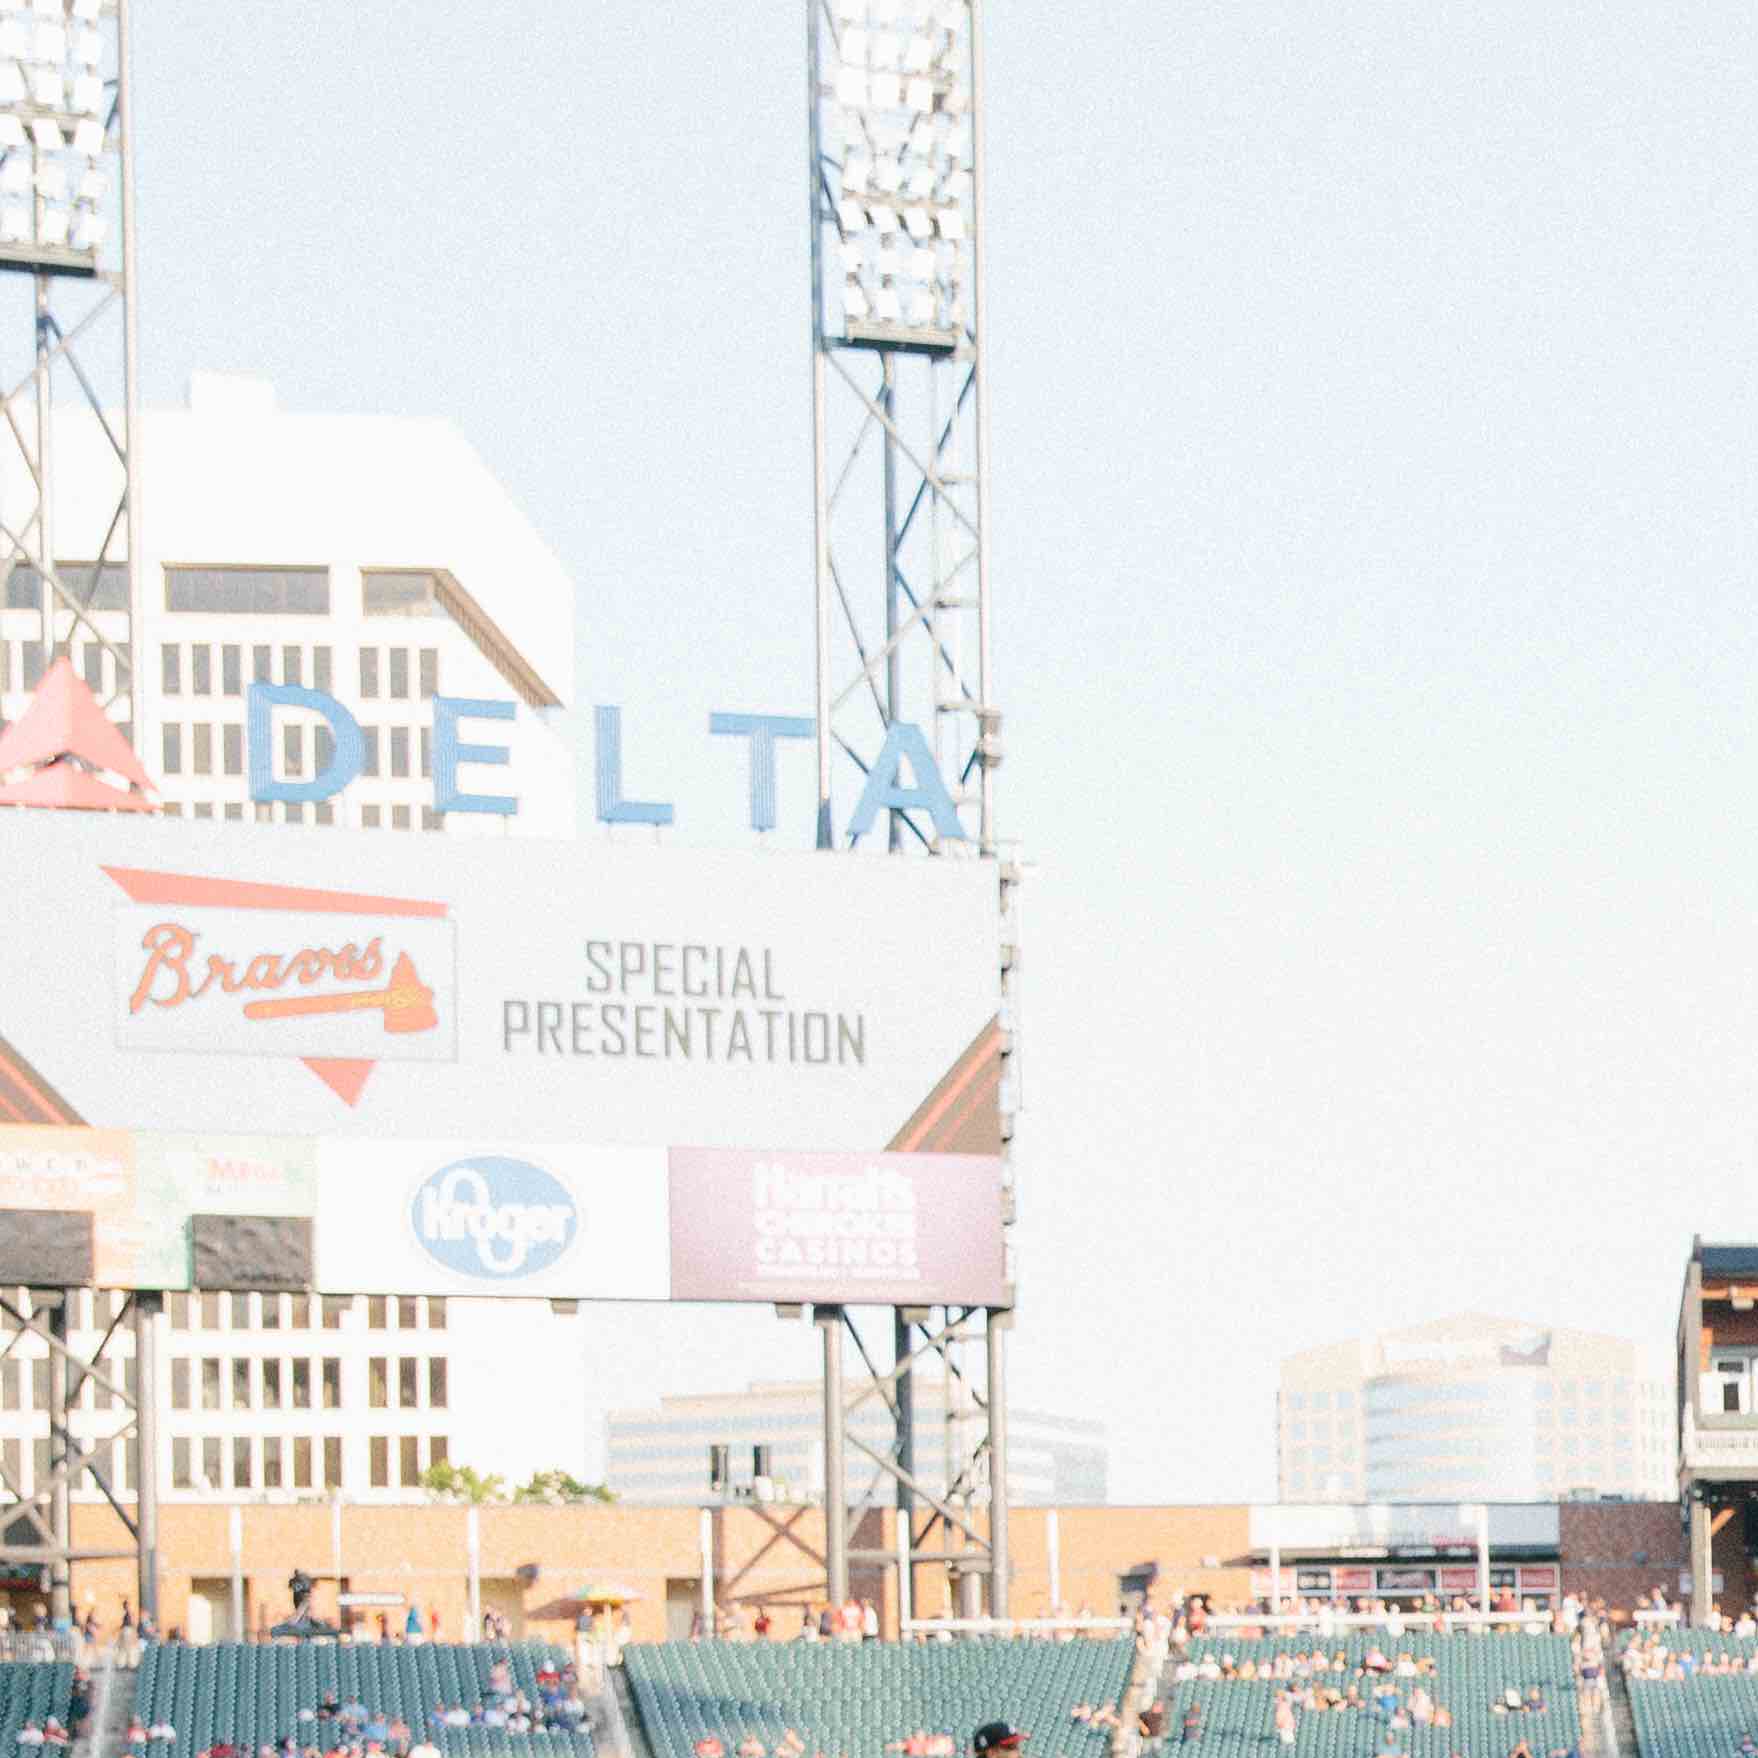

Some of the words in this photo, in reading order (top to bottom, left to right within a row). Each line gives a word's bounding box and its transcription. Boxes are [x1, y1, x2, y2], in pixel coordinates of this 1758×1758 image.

[247, 683, 967, 840] DELTA
[129, 921, 384, 1014] Braves
[583, 938, 786, 1002] SPECIAL
[502, 1000, 867, 1067] PRESENTATION
[421, 1166, 573, 1274] Kroger
